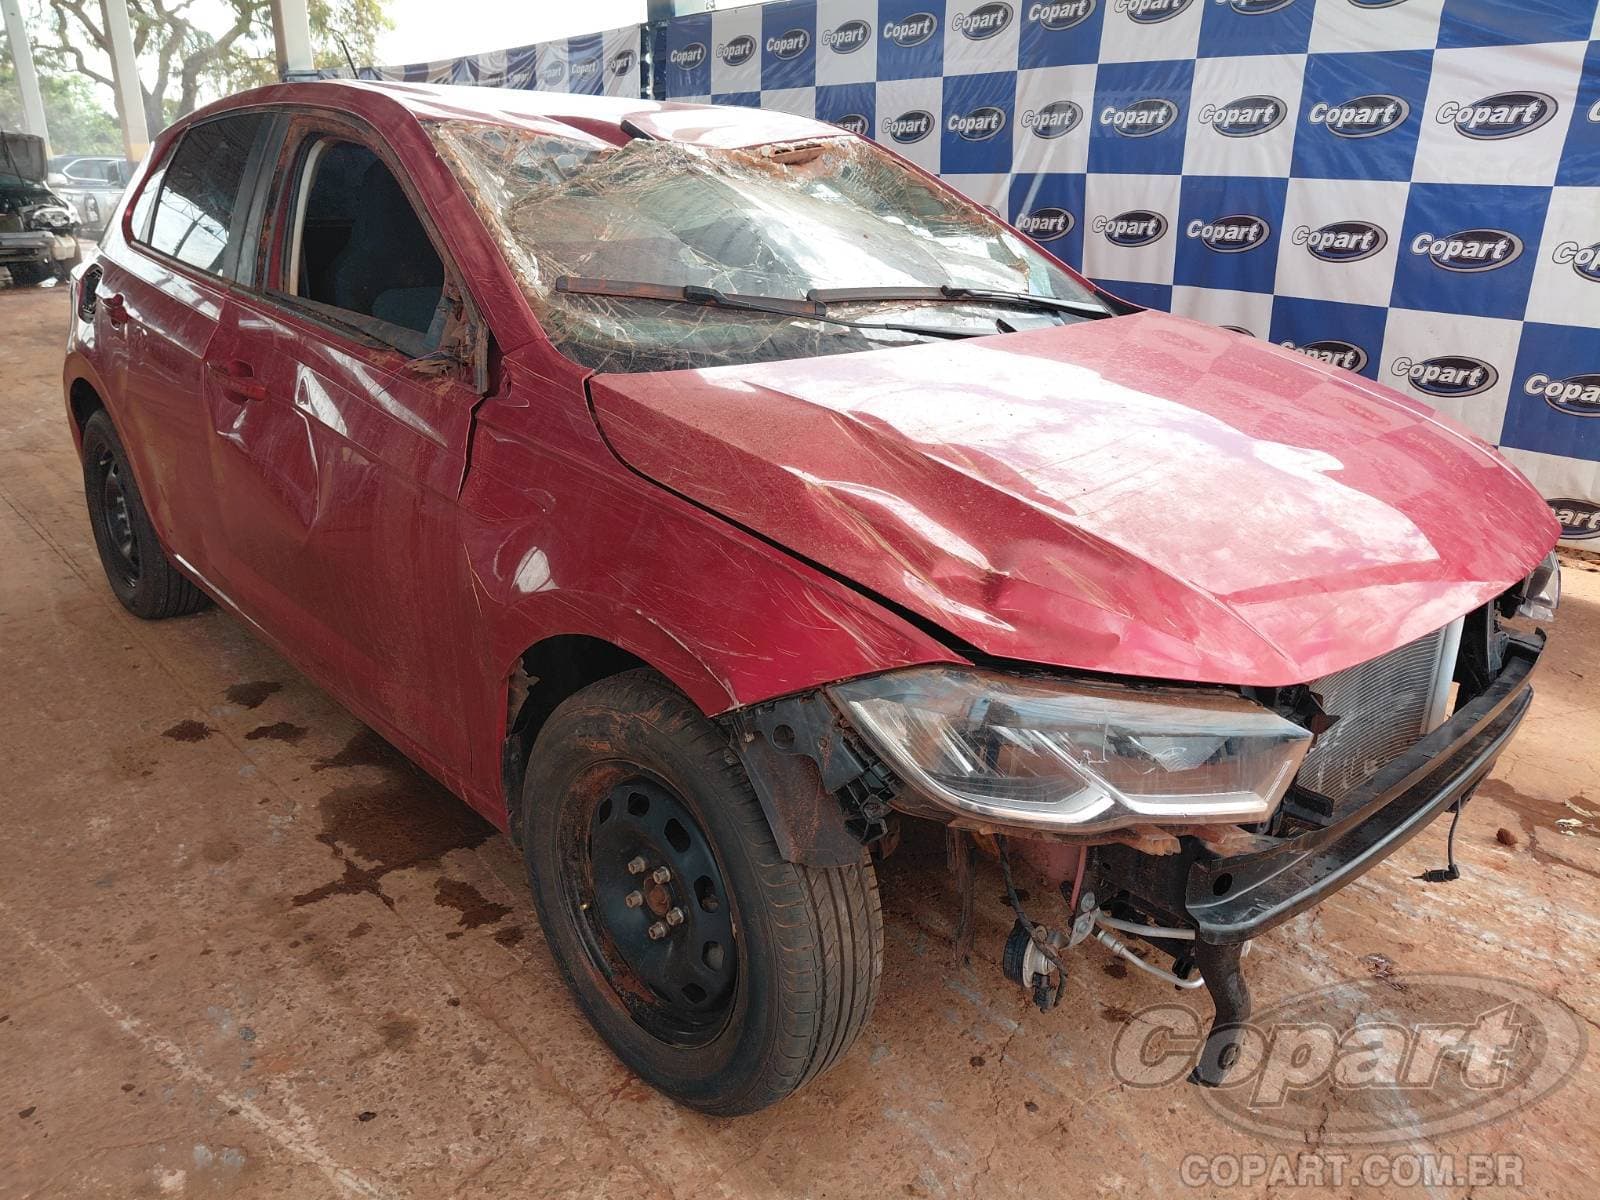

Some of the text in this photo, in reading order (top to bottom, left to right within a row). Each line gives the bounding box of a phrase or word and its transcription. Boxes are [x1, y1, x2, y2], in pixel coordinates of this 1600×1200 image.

[952, 9, 1004, 32] Copart
[1029, 0, 1086, 22] Copart
[822, 25, 865, 48] Copart
[884, 17, 931, 43] Copart
[715, 41, 751, 62] Copart
[766, 34, 804, 54] Copart
[670, 47, 702, 66] Copart
[571, 62, 596, 78] Copart
[948, 110, 998, 133] Copart
[1021, 106, 1074, 132] Copart
[1100, 103, 1169, 132] Copart
[1198, 102, 1275, 131] Copart
[1308, 101, 1399, 129] Copart
[1435, 97, 1541, 129] Copart
[882, 115, 928, 138] Copart
[1015, 213, 1067, 233] Copart
[1092, 213, 1158, 236] Copart
[1186, 219, 1261, 243] Copart
[1291, 225, 1375, 253] Copart
[1411, 232, 1511, 263] Copart
[1391, 356, 1487, 388] Copart
[1524, 373, 1600, 405] Copa
